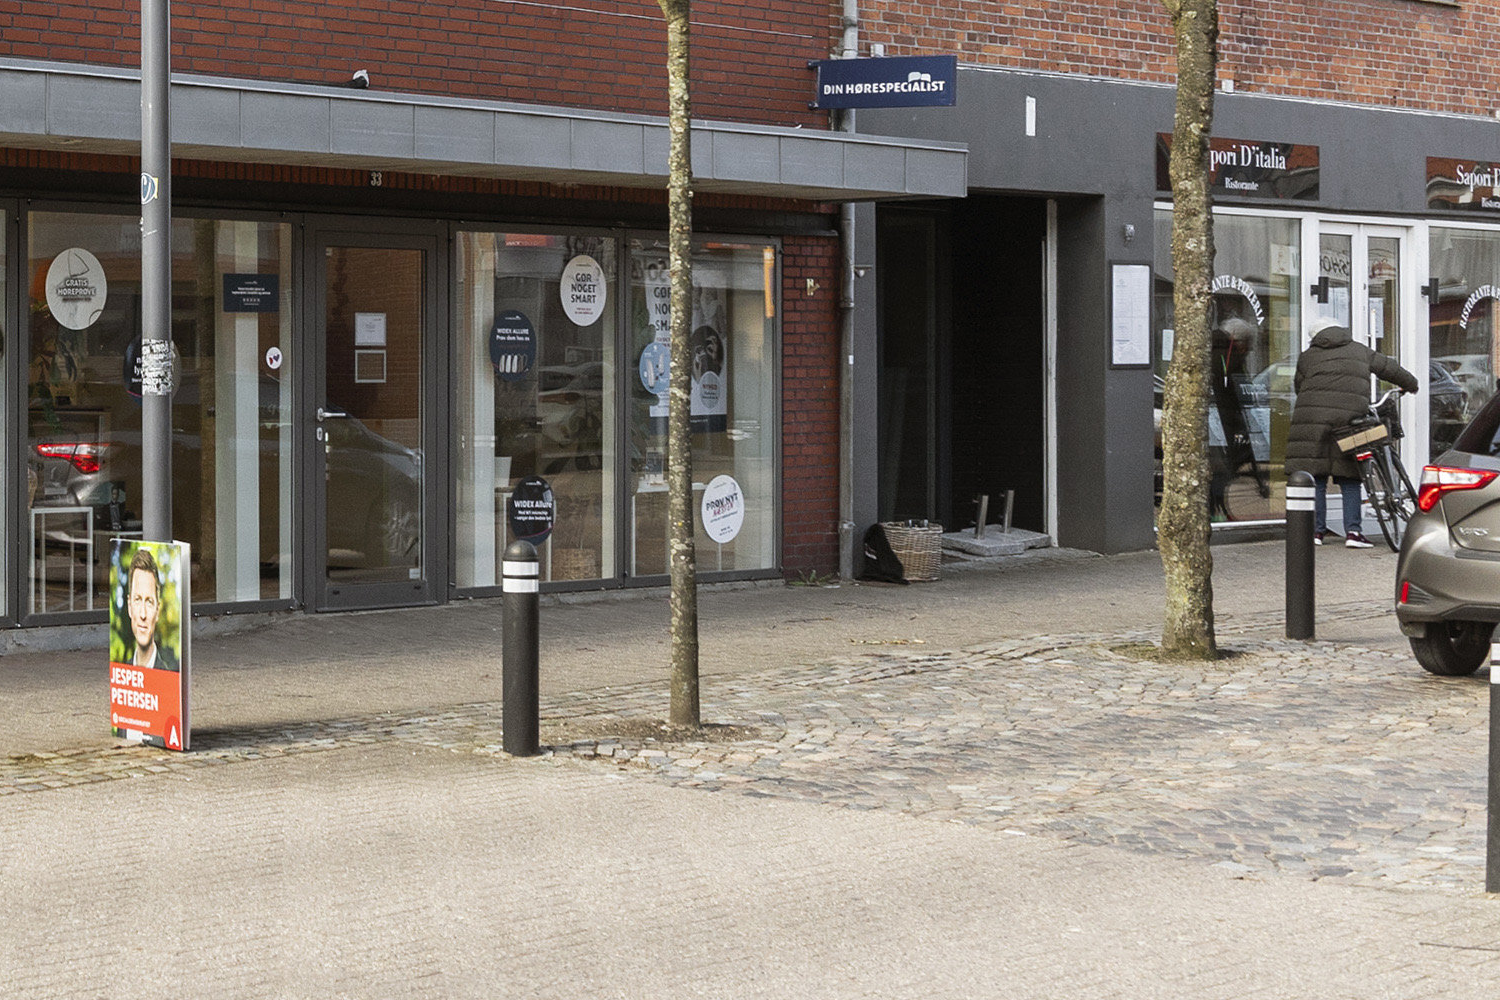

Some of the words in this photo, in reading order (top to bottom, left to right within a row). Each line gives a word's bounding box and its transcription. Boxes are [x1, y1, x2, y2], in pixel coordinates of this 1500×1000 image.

[823, 84, 843, 95] DIN
[845, 81, 945, 94] HØRESPECIALIST
[1210, 144, 1237, 171] pori
[1240, 145, 1286, 170] D'italia
[371, 172, 382, 186] 33
[1225, 177, 1259, 191] Ristorante
[1456, 164, 1492, 192] Sapori
[65, 279, 89, 287] GRATIS
[571, 284, 596, 293] NOGET
[571, 294, 596, 304] SMART
[1238, 278, 1265, 326] PIZZERIA
[1459, 284, 1491, 330] RISTORANTE
[514, 500, 534, 508] WIDEX
[111, 667, 144, 688] JESPER
[112, 687, 158, 712] PETERSEN
[169, 725, 180, 747] A
